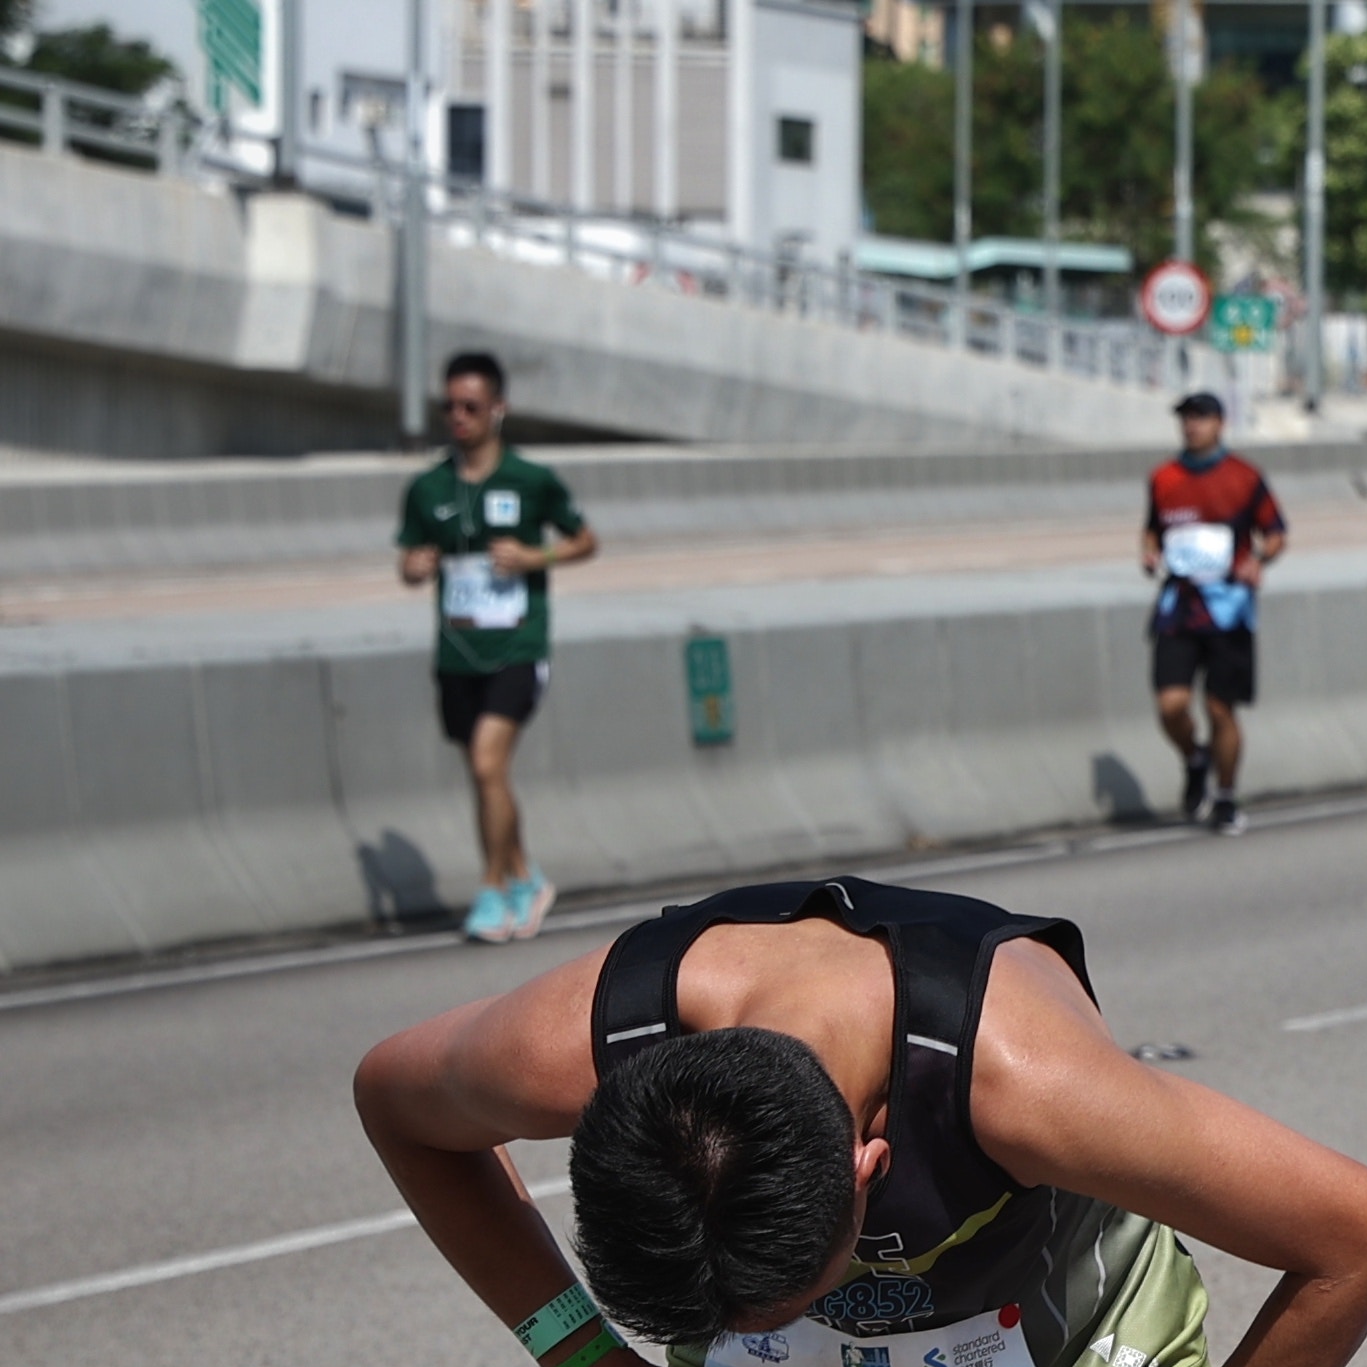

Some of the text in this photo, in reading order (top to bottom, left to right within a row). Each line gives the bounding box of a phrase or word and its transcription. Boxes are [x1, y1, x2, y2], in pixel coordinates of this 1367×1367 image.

[810, 1279, 935, 1321] G852
[952, 1331, 1000, 1355] standard
[954, 1341, 1006, 1365] chartered
